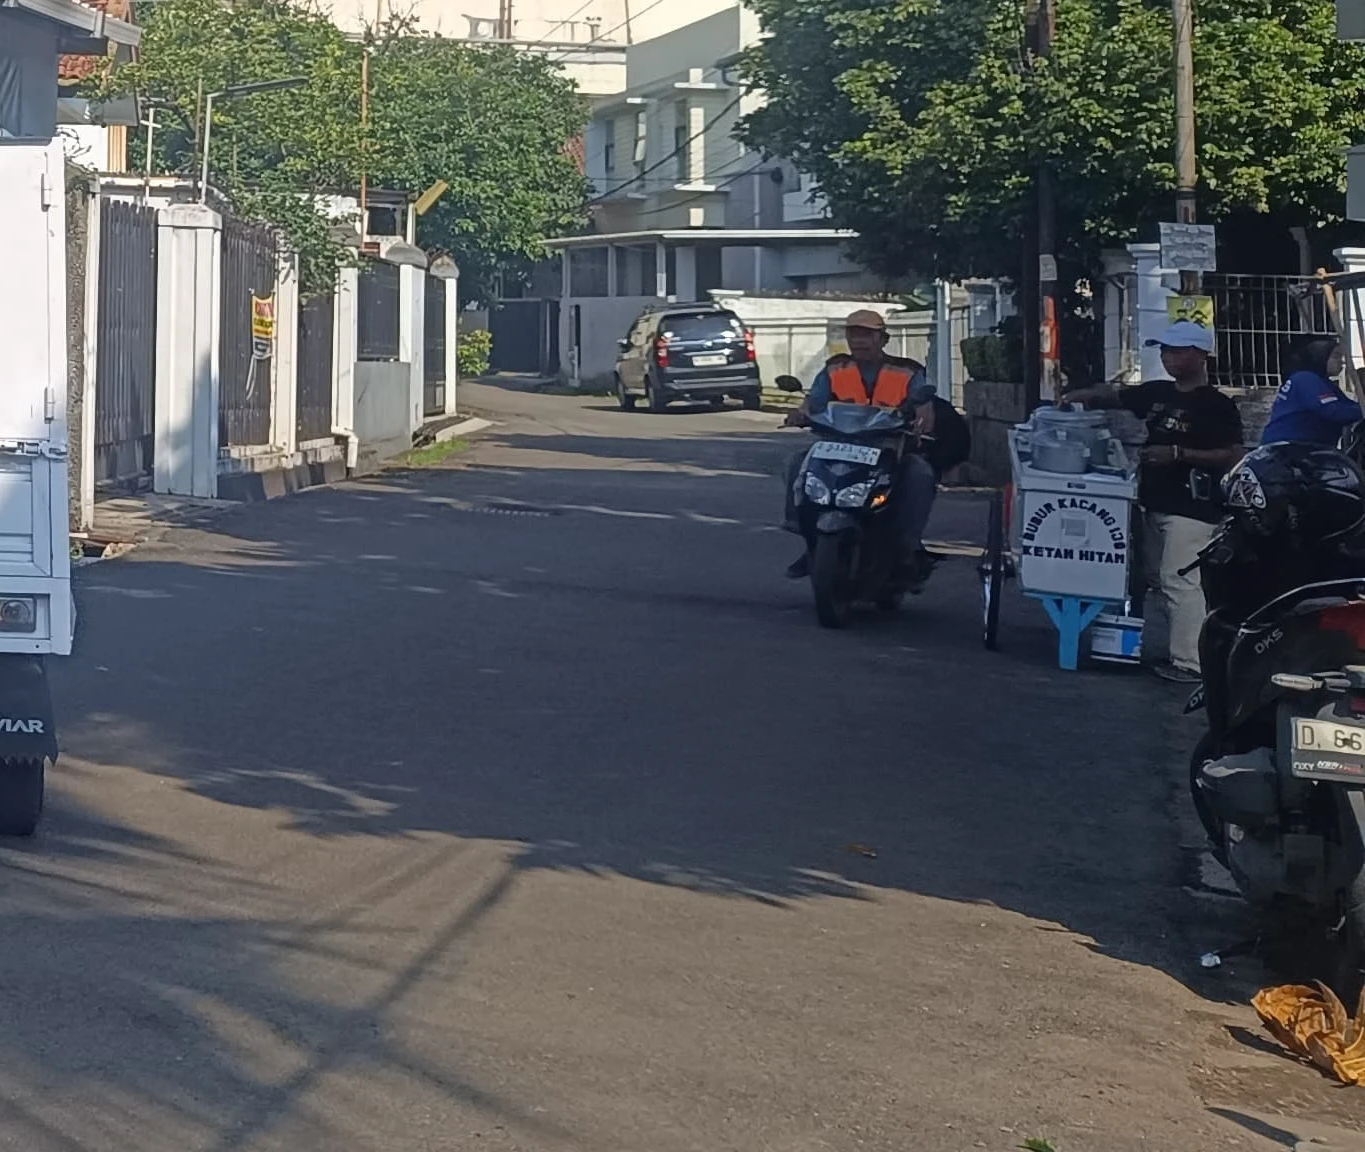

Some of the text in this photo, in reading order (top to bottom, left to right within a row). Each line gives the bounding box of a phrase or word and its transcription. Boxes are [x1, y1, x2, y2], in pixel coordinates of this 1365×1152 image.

[1023, 497, 1127, 550] BUBUR KACANG IJO
[1022, 545, 1126, 564] KETAN HITAM
